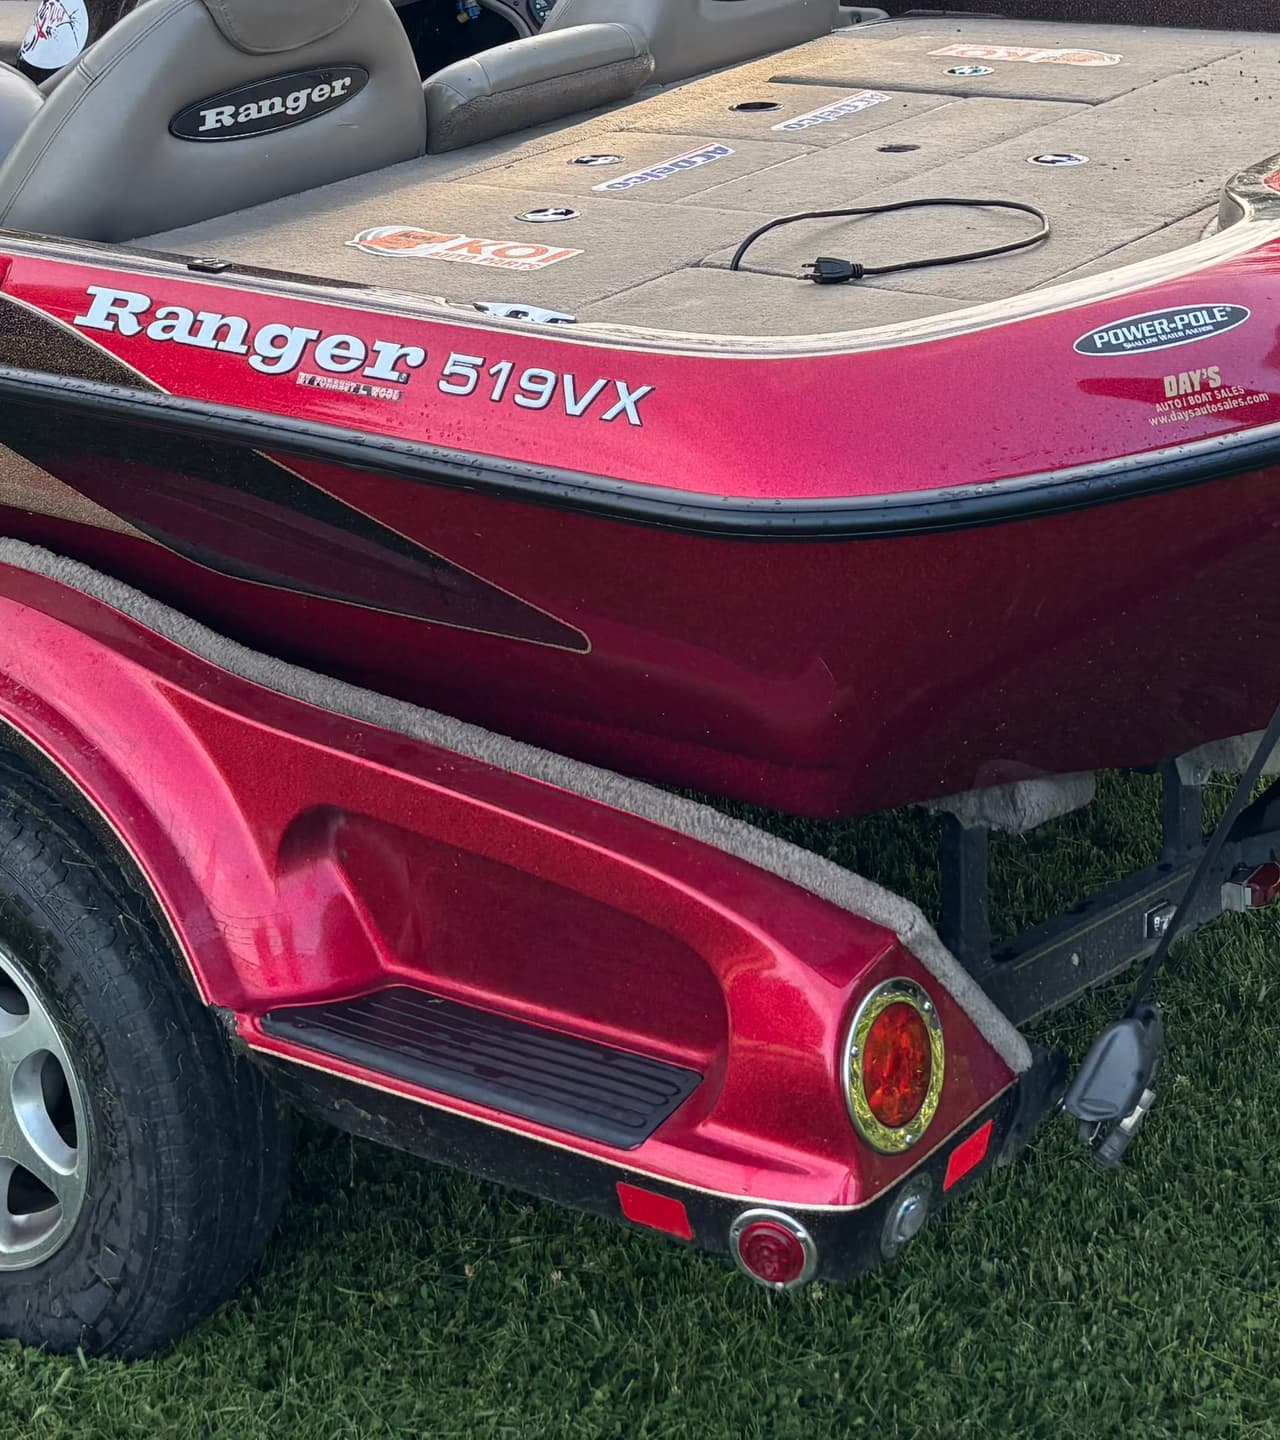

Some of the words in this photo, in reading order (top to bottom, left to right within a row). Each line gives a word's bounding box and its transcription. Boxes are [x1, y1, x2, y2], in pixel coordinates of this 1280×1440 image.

[198, 76, 352, 132] Ranger
[445, 239, 576, 264] KOI
[1093, 307, 1229, 348] POWER-POLE
[72, 284, 426, 381] Ranger
[435, 350, 655, 427] 519VX
[370, 385, 401, 401] WOOD
[1163, 365, 1222, 398] DAY'S
[1155, 399, 1182, 413] AUTO
[1189, 392, 1213, 406] BOAT
[1215, 384, 1246, 400] SALES
